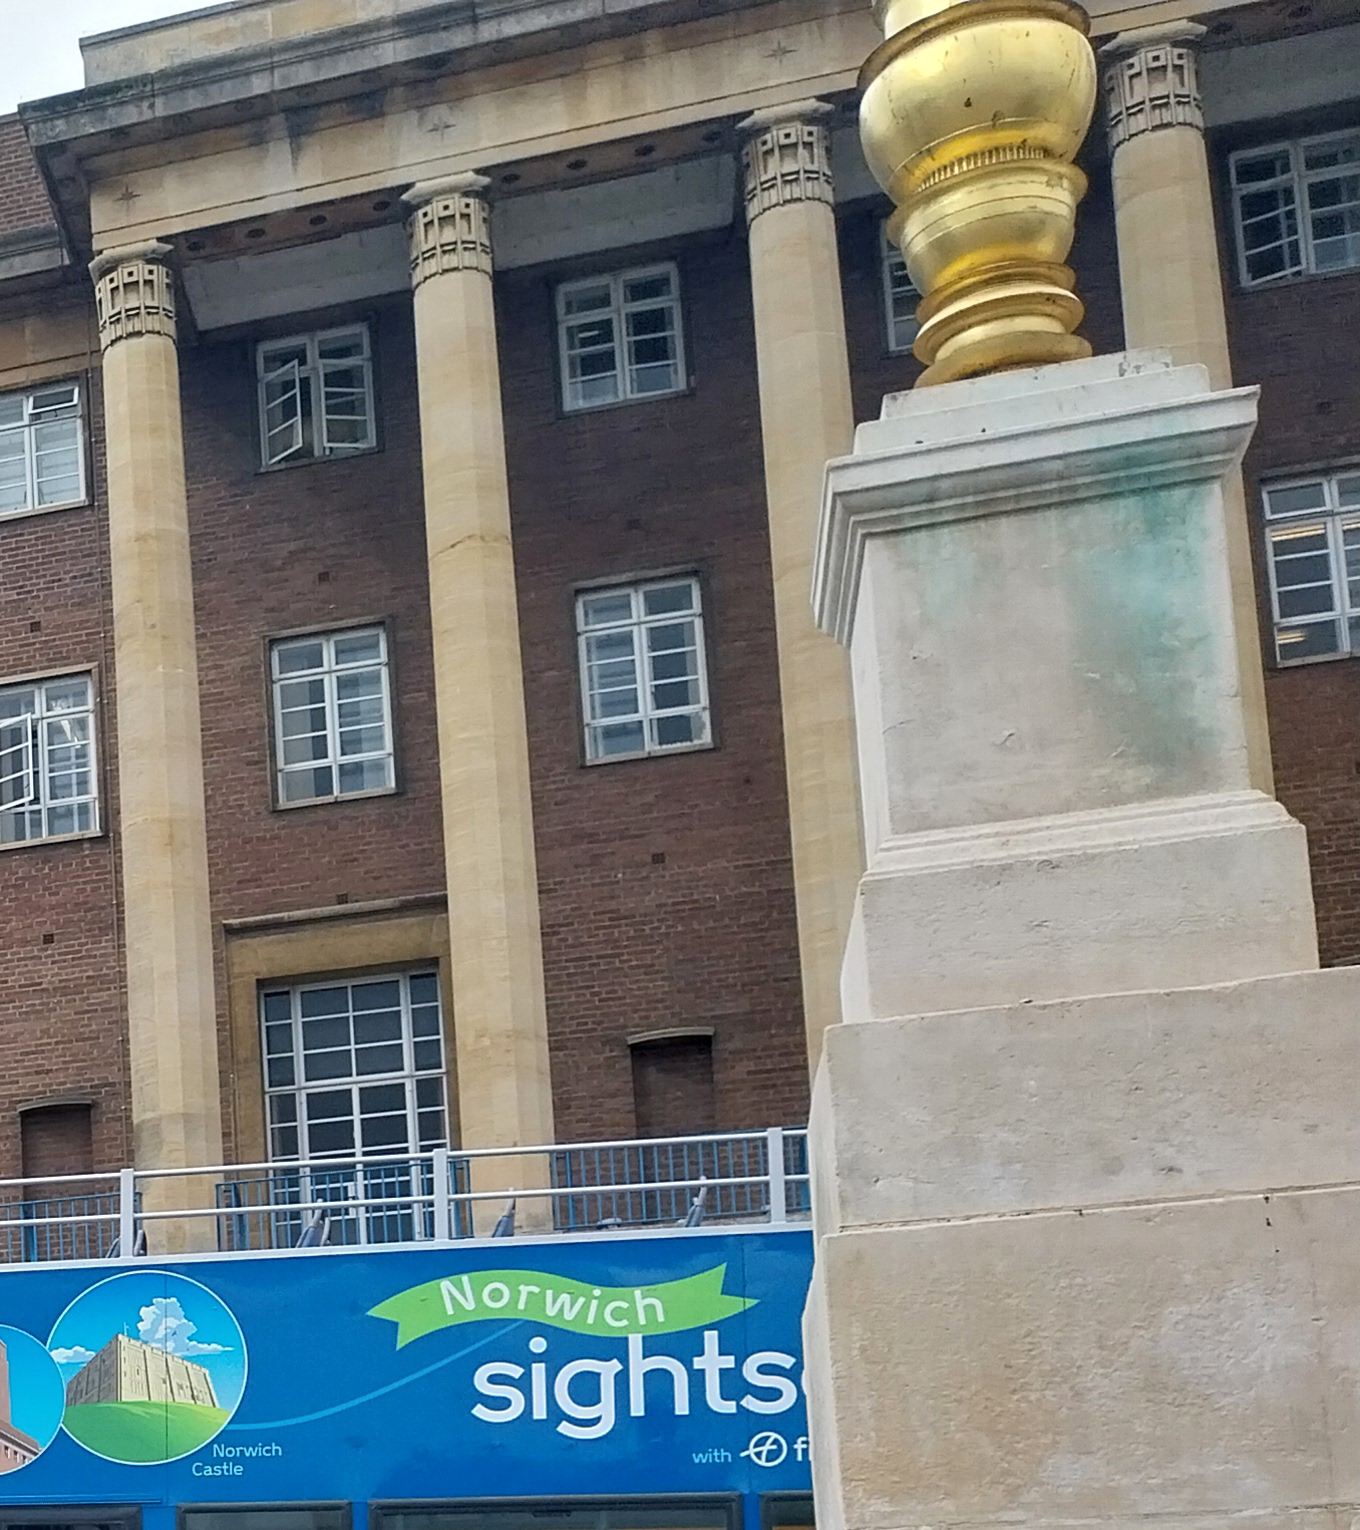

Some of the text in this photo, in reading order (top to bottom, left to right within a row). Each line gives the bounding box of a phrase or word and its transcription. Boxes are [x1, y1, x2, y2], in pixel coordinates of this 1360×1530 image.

[439, 1274, 665, 1328] Norwich
[470, 1330, 808, 1439] sights
[212, 1442, 283, 1457] Norwich
[692, 1448, 732, 1463] with
[191, 1462, 244, 1476] Castle
